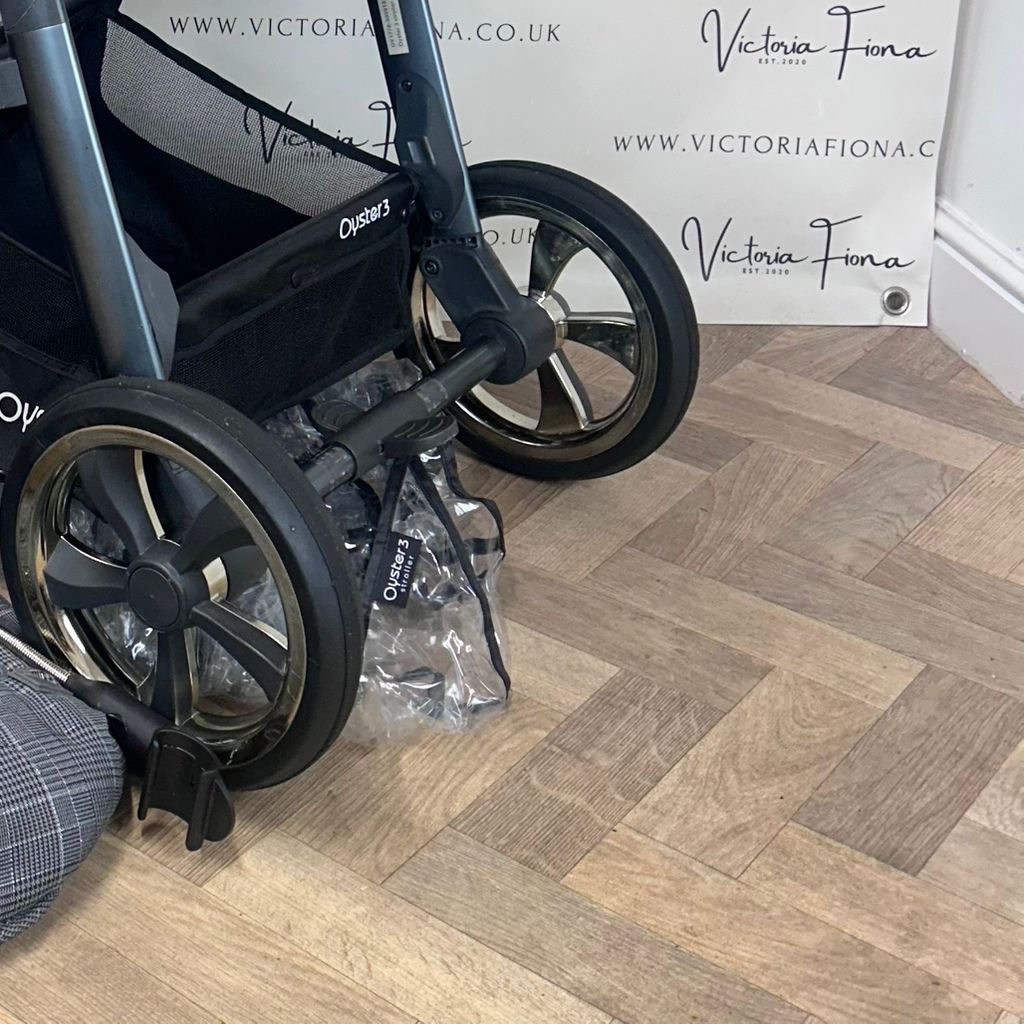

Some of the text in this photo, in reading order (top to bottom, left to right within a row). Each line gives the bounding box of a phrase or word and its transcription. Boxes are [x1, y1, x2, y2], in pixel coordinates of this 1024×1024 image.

[701, 5, 938, 80] Victoria Fiona
[759, 58, 807, 66] EST.2020
[681, 215, 915, 290] Victoria Fiona
[742, 268, 790, 276] EST.2020
